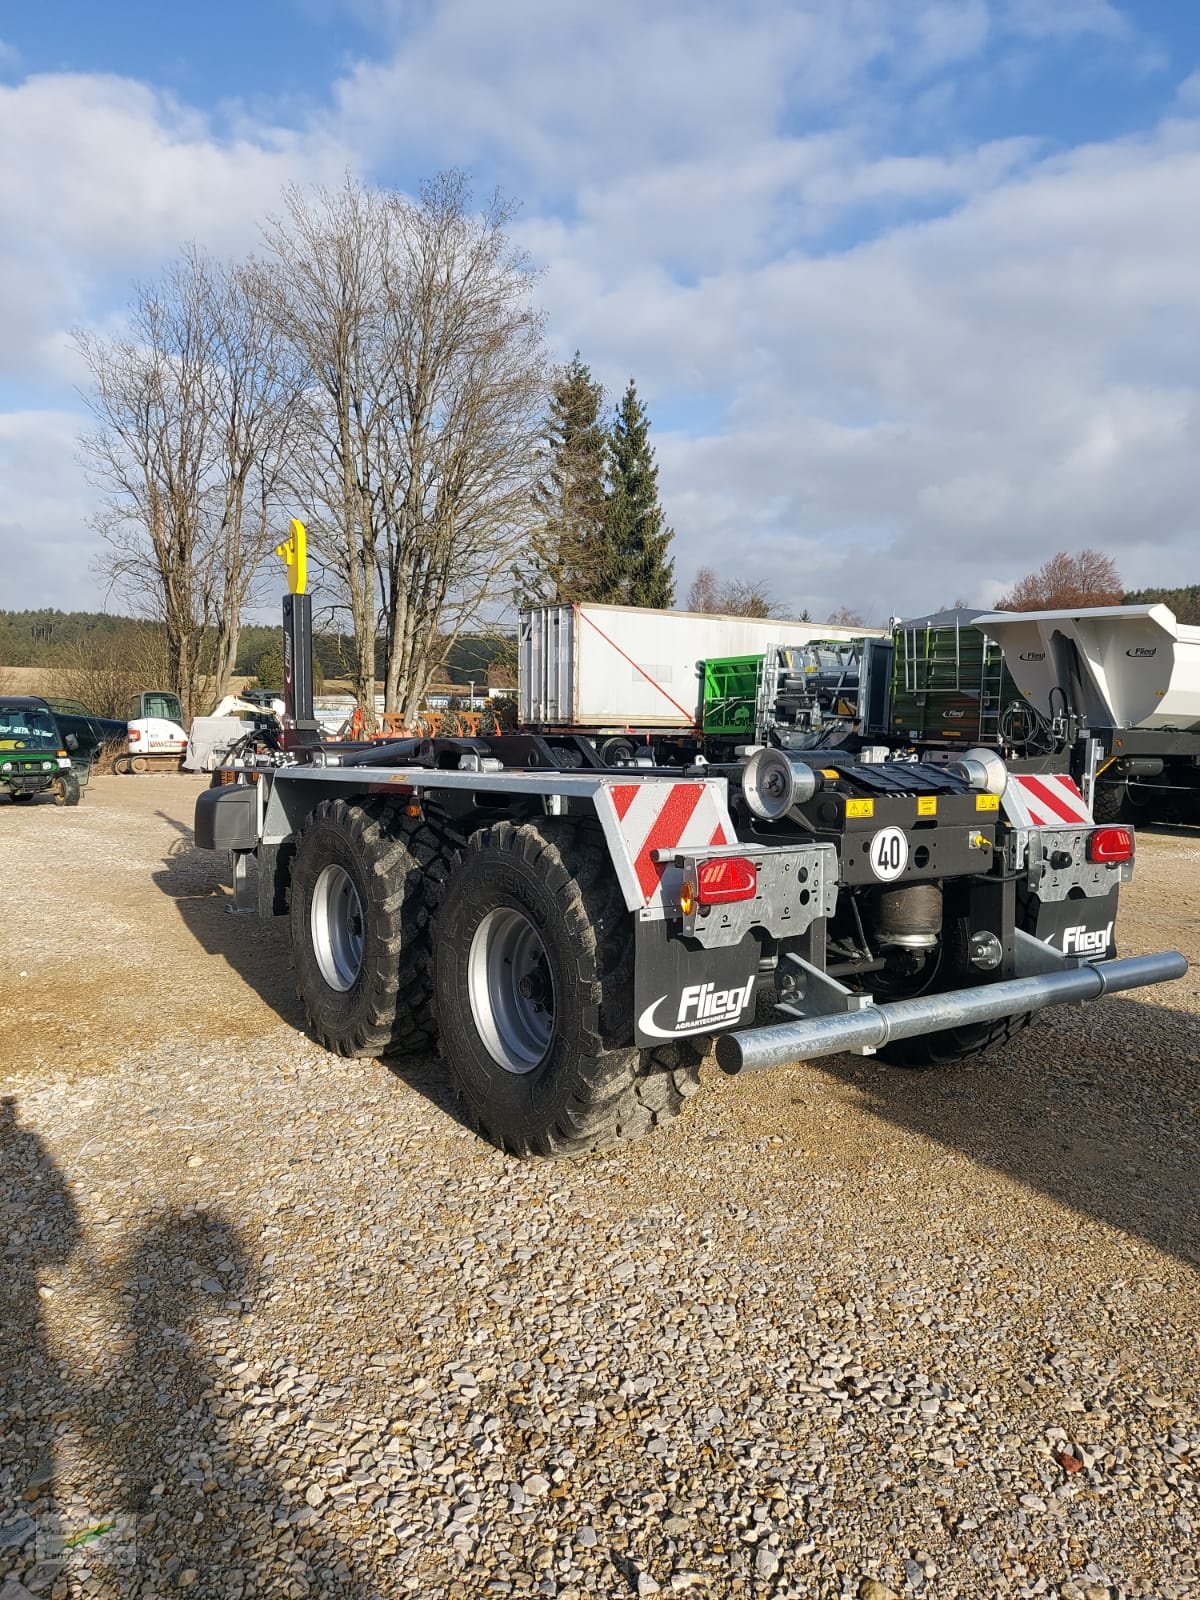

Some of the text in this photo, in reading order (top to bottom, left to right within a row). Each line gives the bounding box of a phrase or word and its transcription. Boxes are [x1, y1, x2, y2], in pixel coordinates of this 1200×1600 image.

[877, 835, 900, 870] 40
[1062, 921, 1114, 954] Fliegl
[677, 974, 755, 1022] Fliegl
[675, 1013, 727, 1031] AGRARTECHNIK
